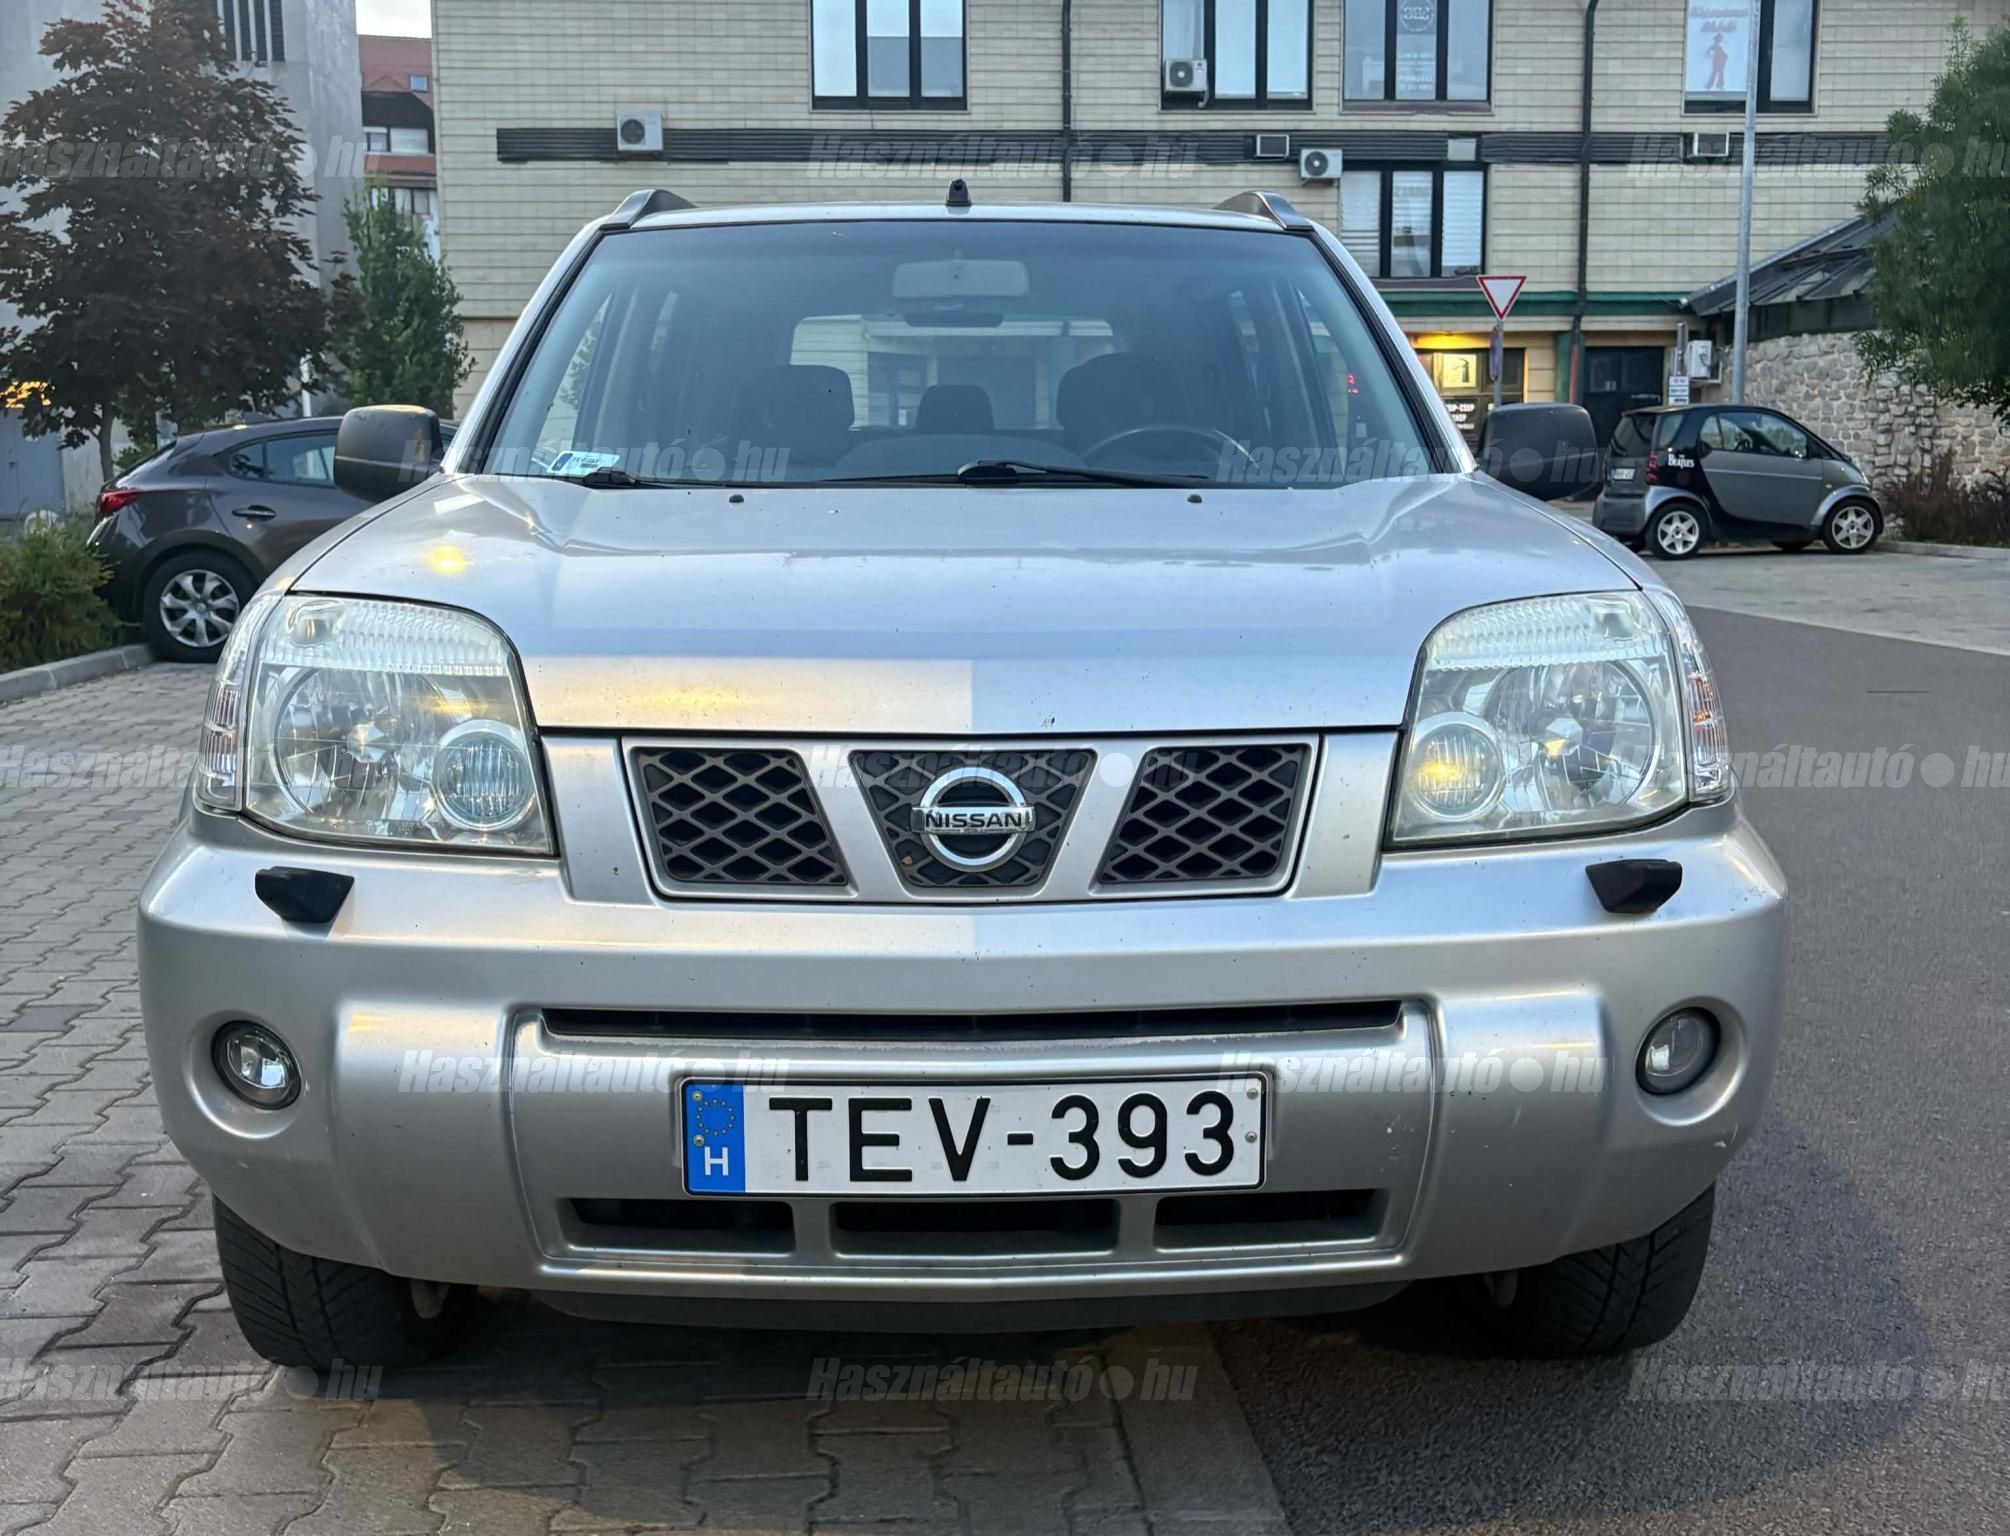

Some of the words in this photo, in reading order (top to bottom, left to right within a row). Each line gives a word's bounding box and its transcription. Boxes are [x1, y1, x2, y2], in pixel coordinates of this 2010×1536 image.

[925, 812, 1023, 828] NISSAN
[768, 1089, 1236, 1183] TEV-393
[703, 1147, 729, 1176] H
